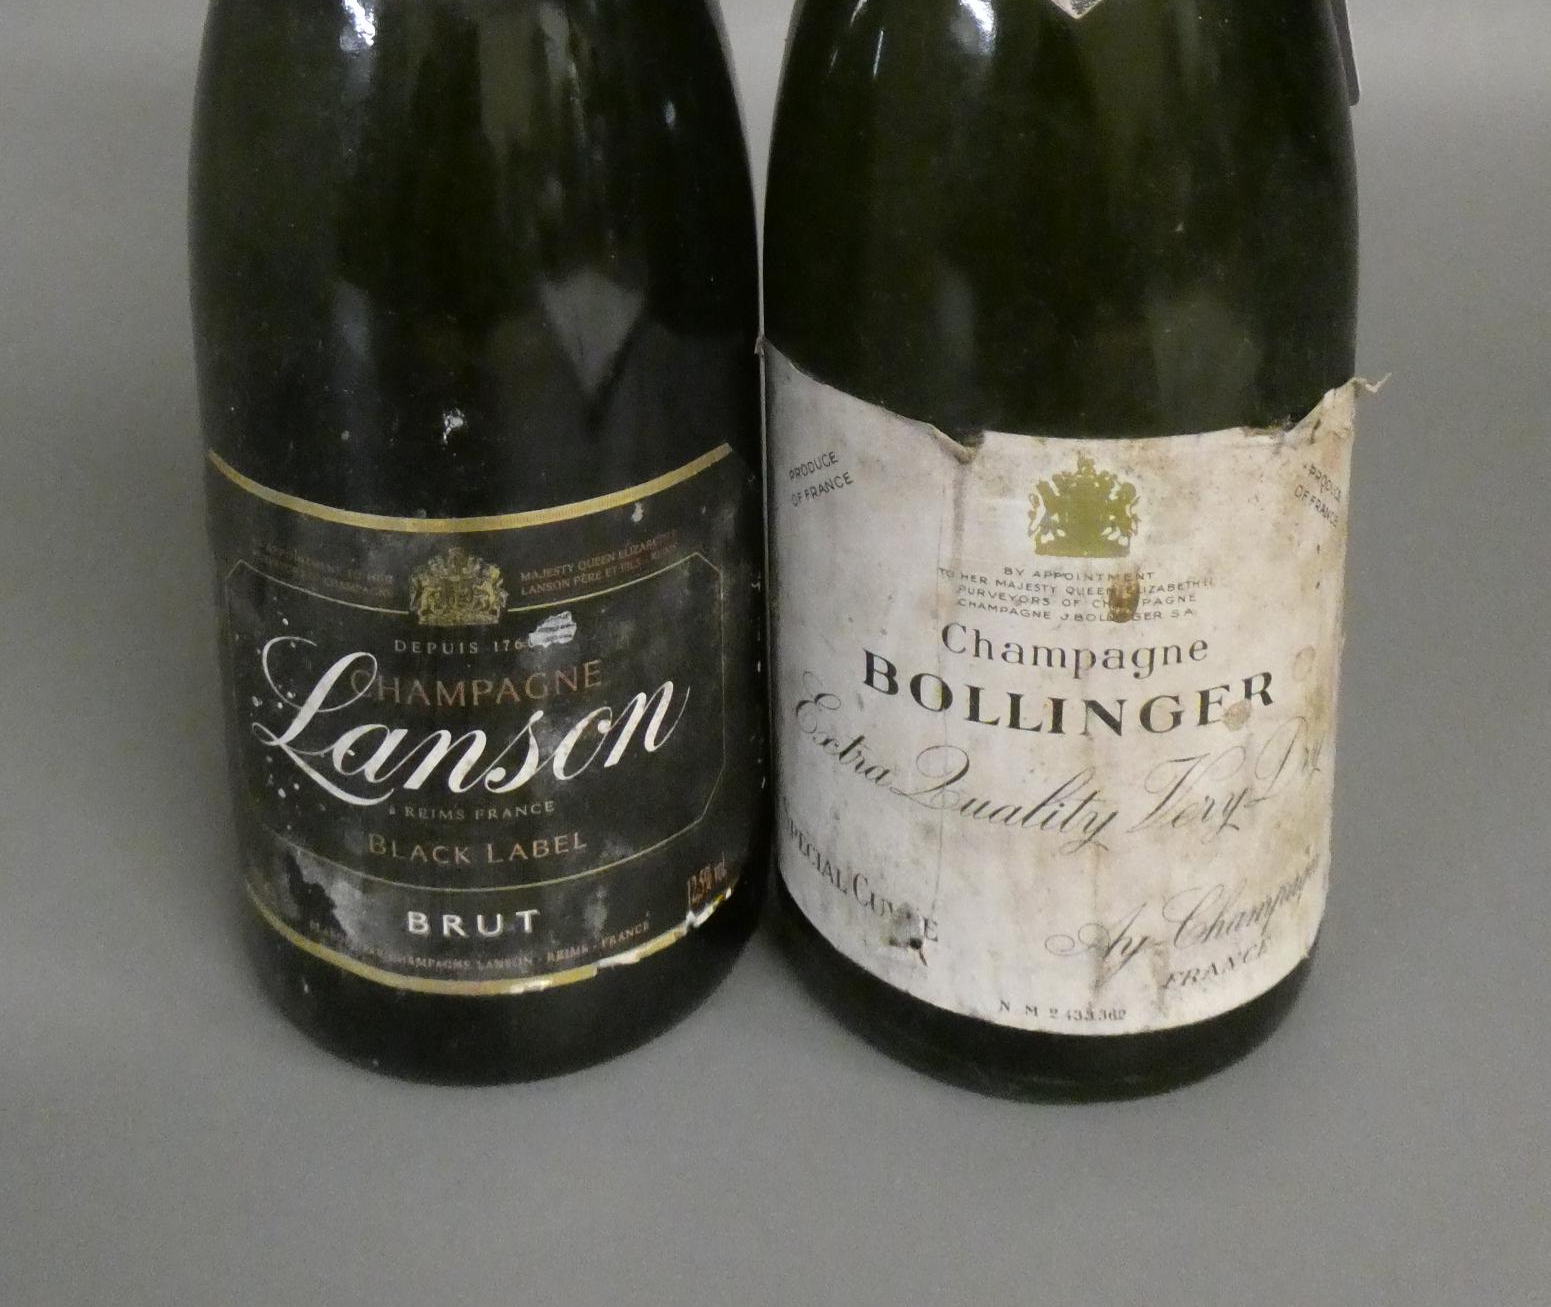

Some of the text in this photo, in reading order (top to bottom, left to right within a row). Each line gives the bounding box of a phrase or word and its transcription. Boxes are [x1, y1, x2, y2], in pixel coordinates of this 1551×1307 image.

[788, 450, 839, 481] PRODUCE
[791, 471, 855, 508] OF FRANCE
[1294, 484, 1311, 501] OF
[520, 561, 574, 582] MAJESTY
[577, 550, 616, 572] QUEEN
[1003, 566, 1155, 581] BY APPOINTMENT
[520, 577, 570, 596] LANSON
[937, 567, 955, 578] TO
[960, 573, 988, 584] HER
[995, 579, 1057, 594] MAJESTY
[1065, 584, 1116, 597] QUEEN
[958, 584, 1198, 609] PURVEYORS OF CHPAGNE
[957, 598, 1051, 620] CHAMPAGNE
[394, 638, 478, 655] DEPUIS
[941, 622, 1209, 680] Champagne
[351, 659, 603, 708] CHAMPAGNE
[862, 647, 1275, 737] BOLLINGER
[252, 636, 691, 807] Lanson
[795, 686, 893, 787] Extra
[889, 745, 1120, 856] Quality
[404, 804, 465, 821] REIMS
[475, 800, 556, 821] FRANCE
[368, 832, 587, 865] BLACK LABEL
[852, 872, 939, 943] CUVE
[408, 908, 541, 939] BRUT
[601, 919, 650, 948] FRANCE
